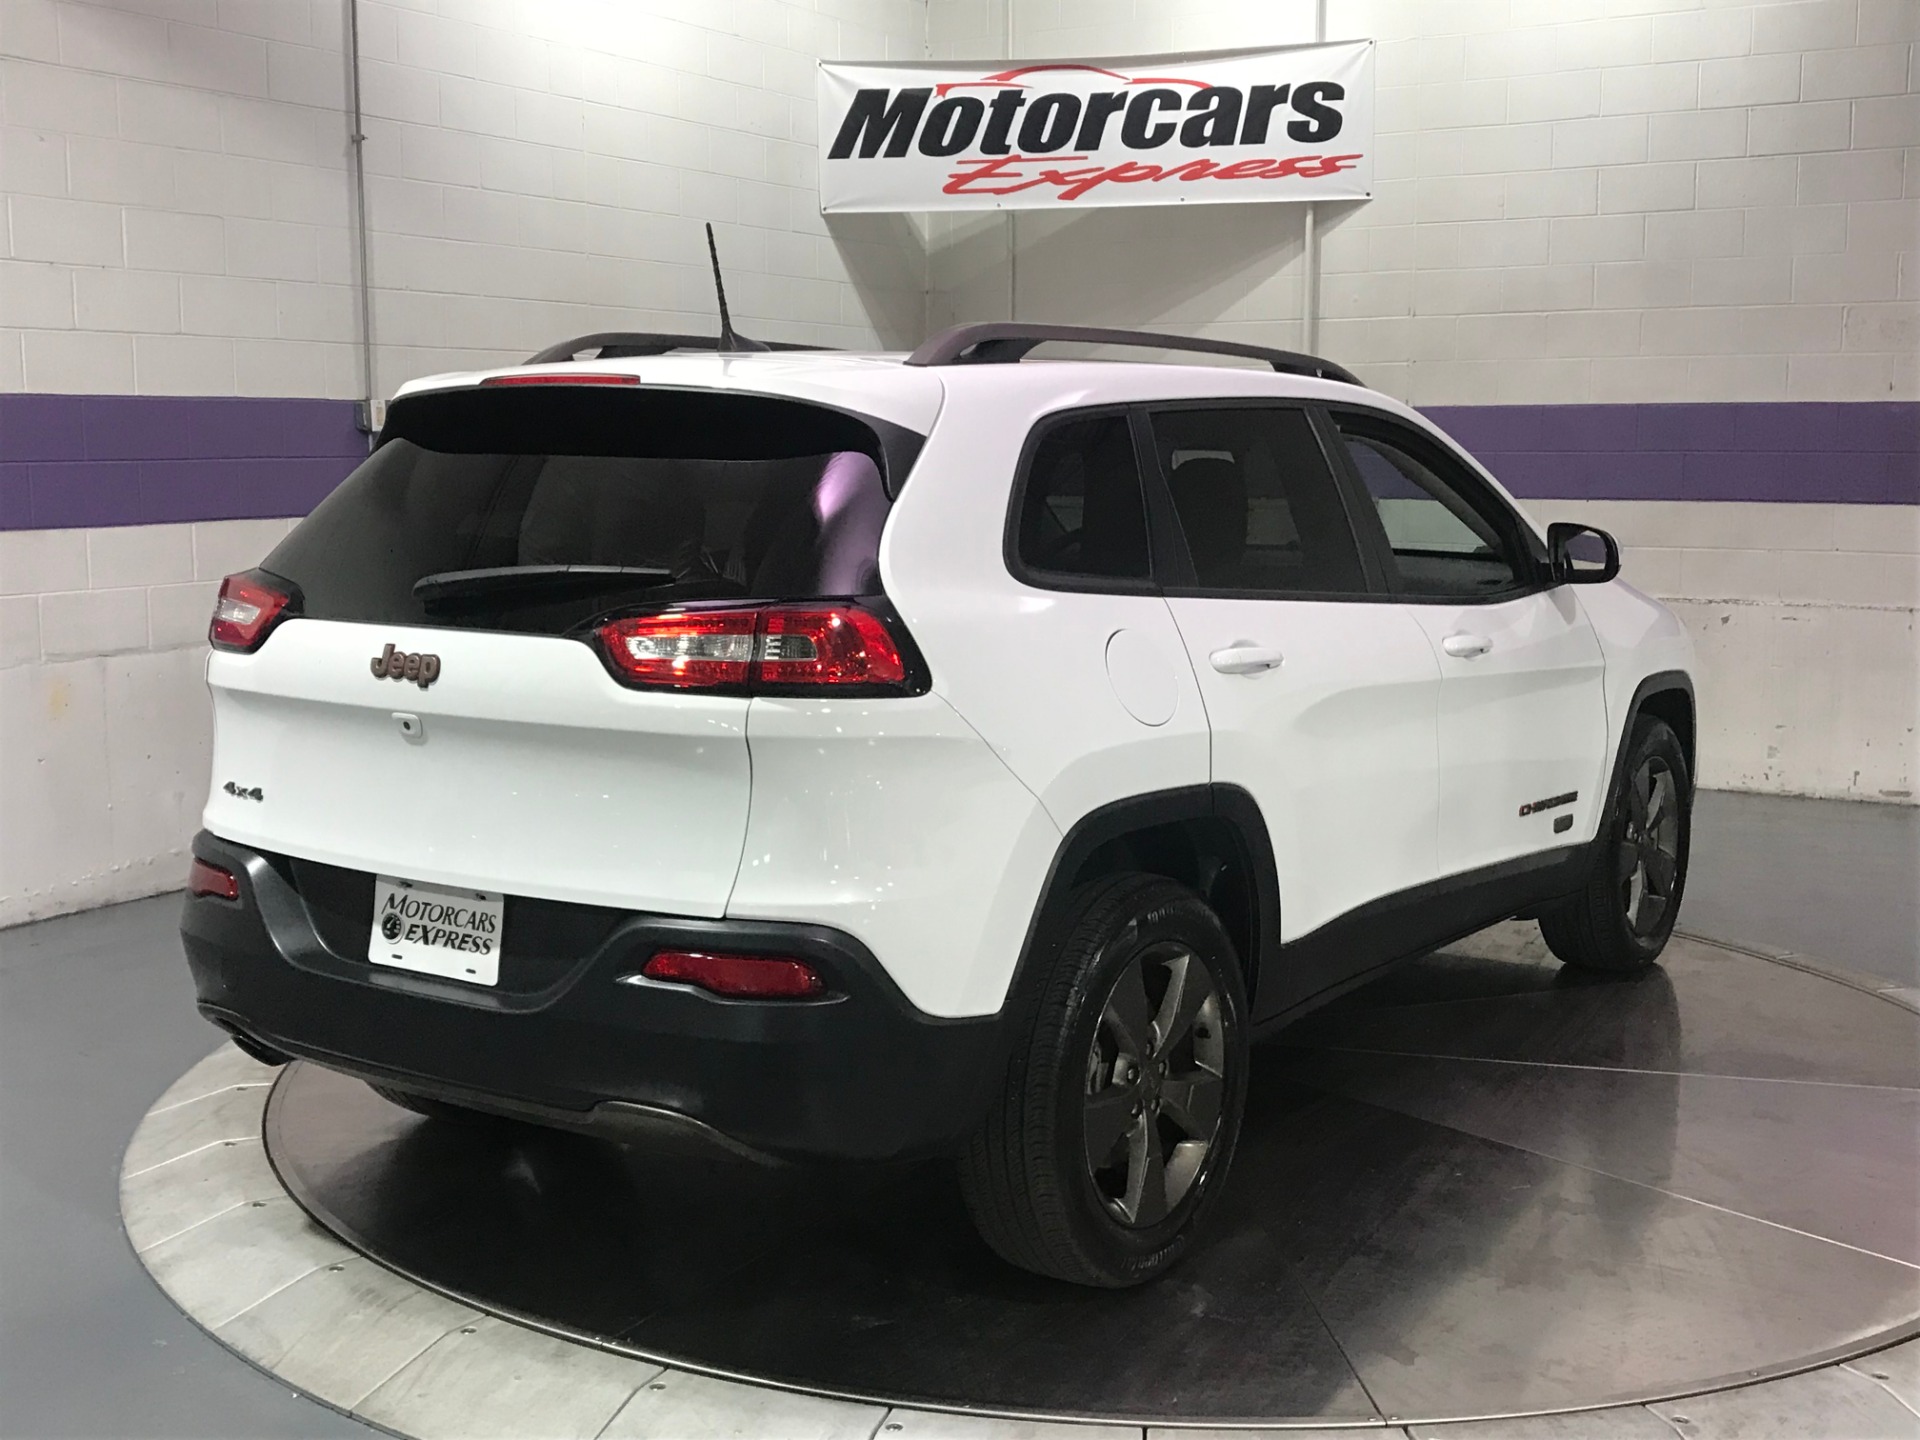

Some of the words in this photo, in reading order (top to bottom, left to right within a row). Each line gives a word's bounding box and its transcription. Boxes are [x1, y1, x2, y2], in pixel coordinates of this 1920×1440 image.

[827, 80, 1345, 159] Motorcars
[941, 153, 1364, 200] Express
[370, 643, 441, 689] Jeep
[223, 781, 264, 802] 4x4
[381, 892, 497, 934] MOTORCARS
[404, 923, 494, 956] EXPRESS
